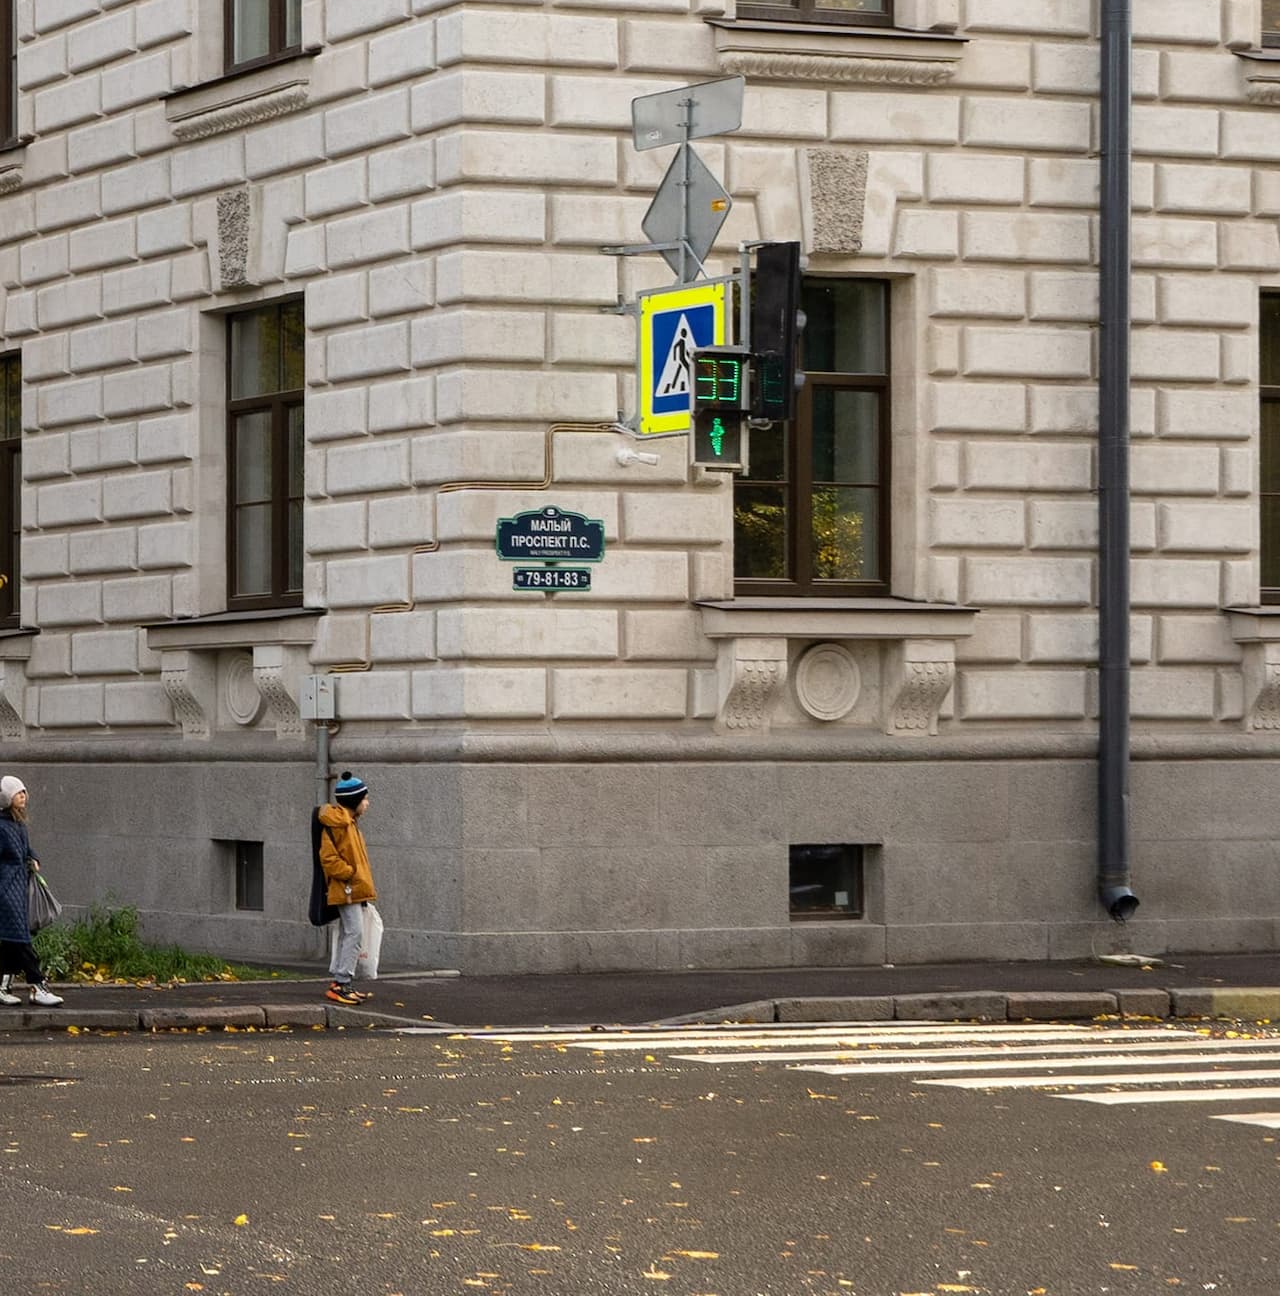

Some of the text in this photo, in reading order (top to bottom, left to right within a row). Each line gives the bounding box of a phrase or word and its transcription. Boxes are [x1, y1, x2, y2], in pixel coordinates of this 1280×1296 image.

[697, 359, 739, 401] 33
[531, 518, 572, 532] МАЛЫЙ
[511, 535, 591, 549] ПРОСПЕКТ П.С.
[526, 572, 579, 586] 79-81-83
